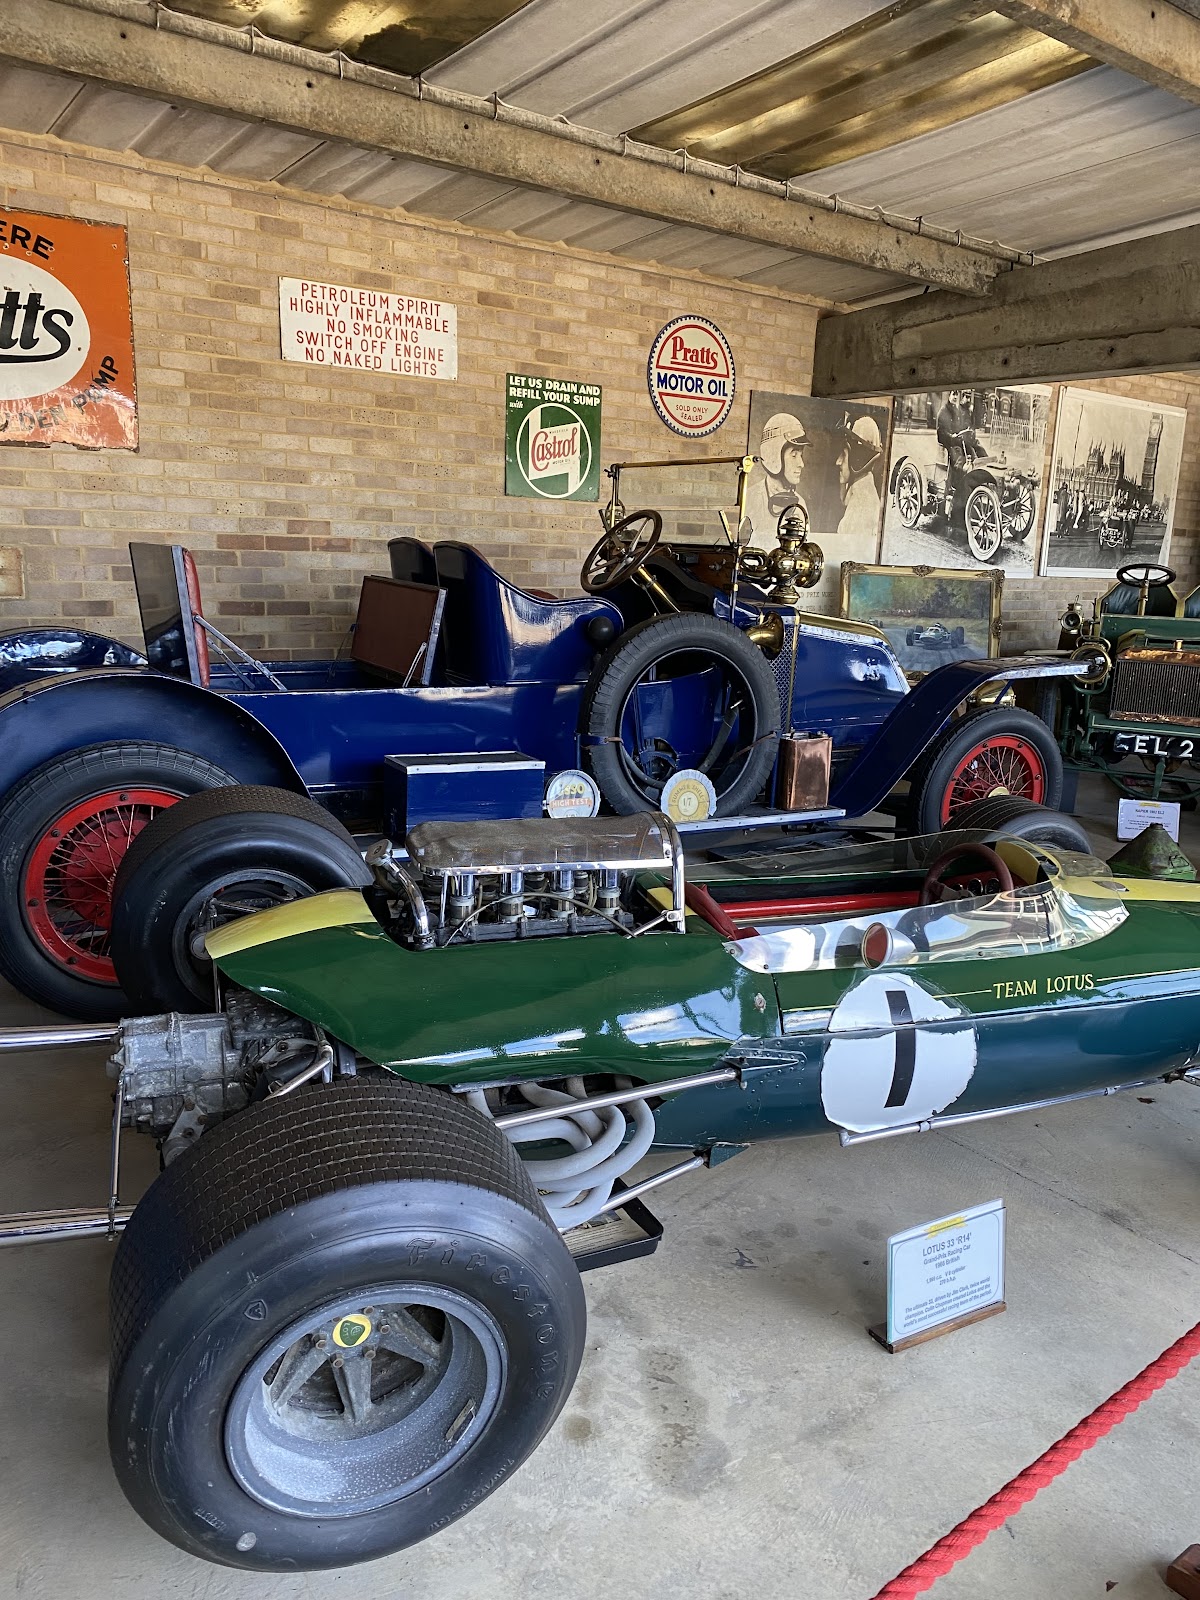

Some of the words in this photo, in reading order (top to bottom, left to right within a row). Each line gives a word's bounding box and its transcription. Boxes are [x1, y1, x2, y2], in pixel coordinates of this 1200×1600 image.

[301, 283, 389, 309] PETROLEUM
[397, 298, 440, 316] SPIRIT
[290, 297, 339, 317] HIGHLY
[350, 306, 449, 333] INFLAMMABLE
[327, 318, 346, 333] NO
[353, 322, 419, 343] SMOKING
[296, 330, 353, 350] SWITCH
[360, 339, 387, 354] OFF
[395, 343, 444, 362] ENGINE
[671, 335, 718, 370] Pratts
[305, 348, 325, 362] NO
[333, 351, 382, 369] NAKED
[391, 358, 437, 376] LIGHTS
[72, 355, 119, 415] PUMP
[509, 375, 527, 387] LET
[528, 378, 543, 389] US
[545, 380, 578, 394] DRAIN
[579, 385, 600, 396] AND
[509, 387, 542, 400] REFILL
[542, 391, 571, 404] YOUR
[573, 395, 600, 407] SUMP
[657, 372, 704, 394] MOTOR
[708, 379, 728, 397] OIL
[675, 404, 691, 412] SOLD
[680, 413, 703, 422] SEALED
[531, 427, 578, 471] Castrol
[1180, 739, 1194, 758] 2
[552, 800, 570, 808] HIGH
[671, 784, 690, 803] SUMMER
[993, 979, 1037, 999] TEAM
[1046, 974, 1094, 993] LOTUS
[884, 990, 917, 1109] 1
[923, 1242, 945, 1257] LOTUS
[947, 1238, 954, 1248] 33
[948, 1247, 962, 1257] Racing
[963, 1243, 971, 1251] Car
[935, 1294, 946, 1302] driven
[406, 1237, 559, 1398] Firestone
